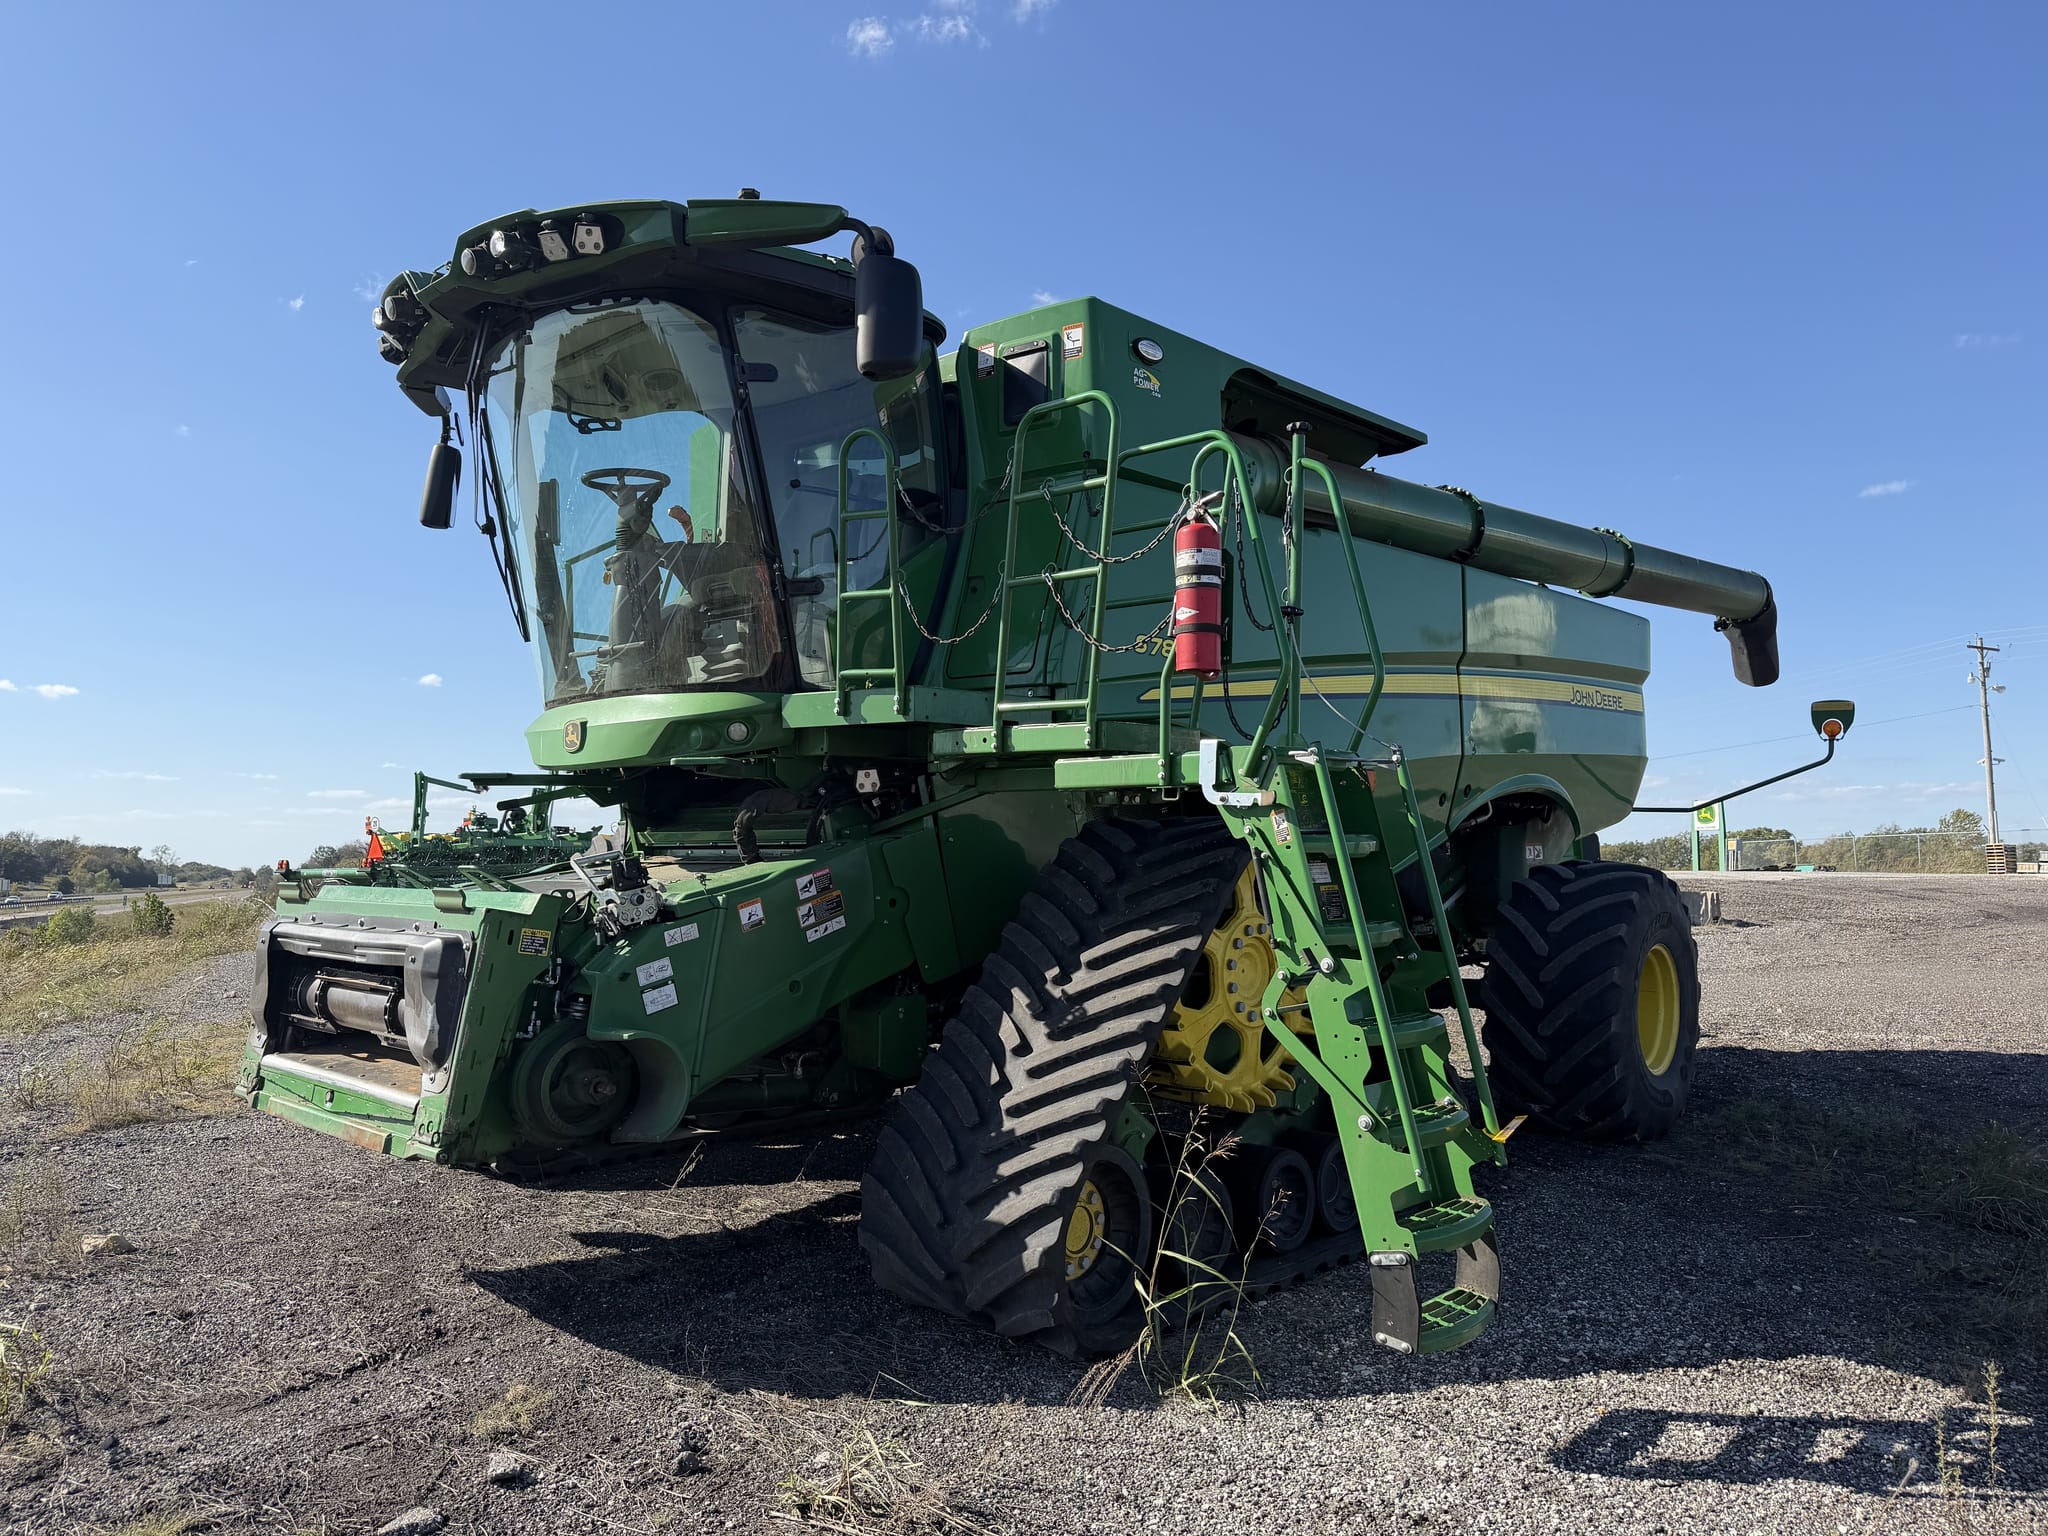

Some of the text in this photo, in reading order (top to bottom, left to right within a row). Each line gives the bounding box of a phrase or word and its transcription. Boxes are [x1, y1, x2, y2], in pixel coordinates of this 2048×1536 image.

[1133, 375, 1161, 393] POWER
[1135, 634, 1177, 657] S78
[1570, 685, 1624, 710] JOHN DEERE
